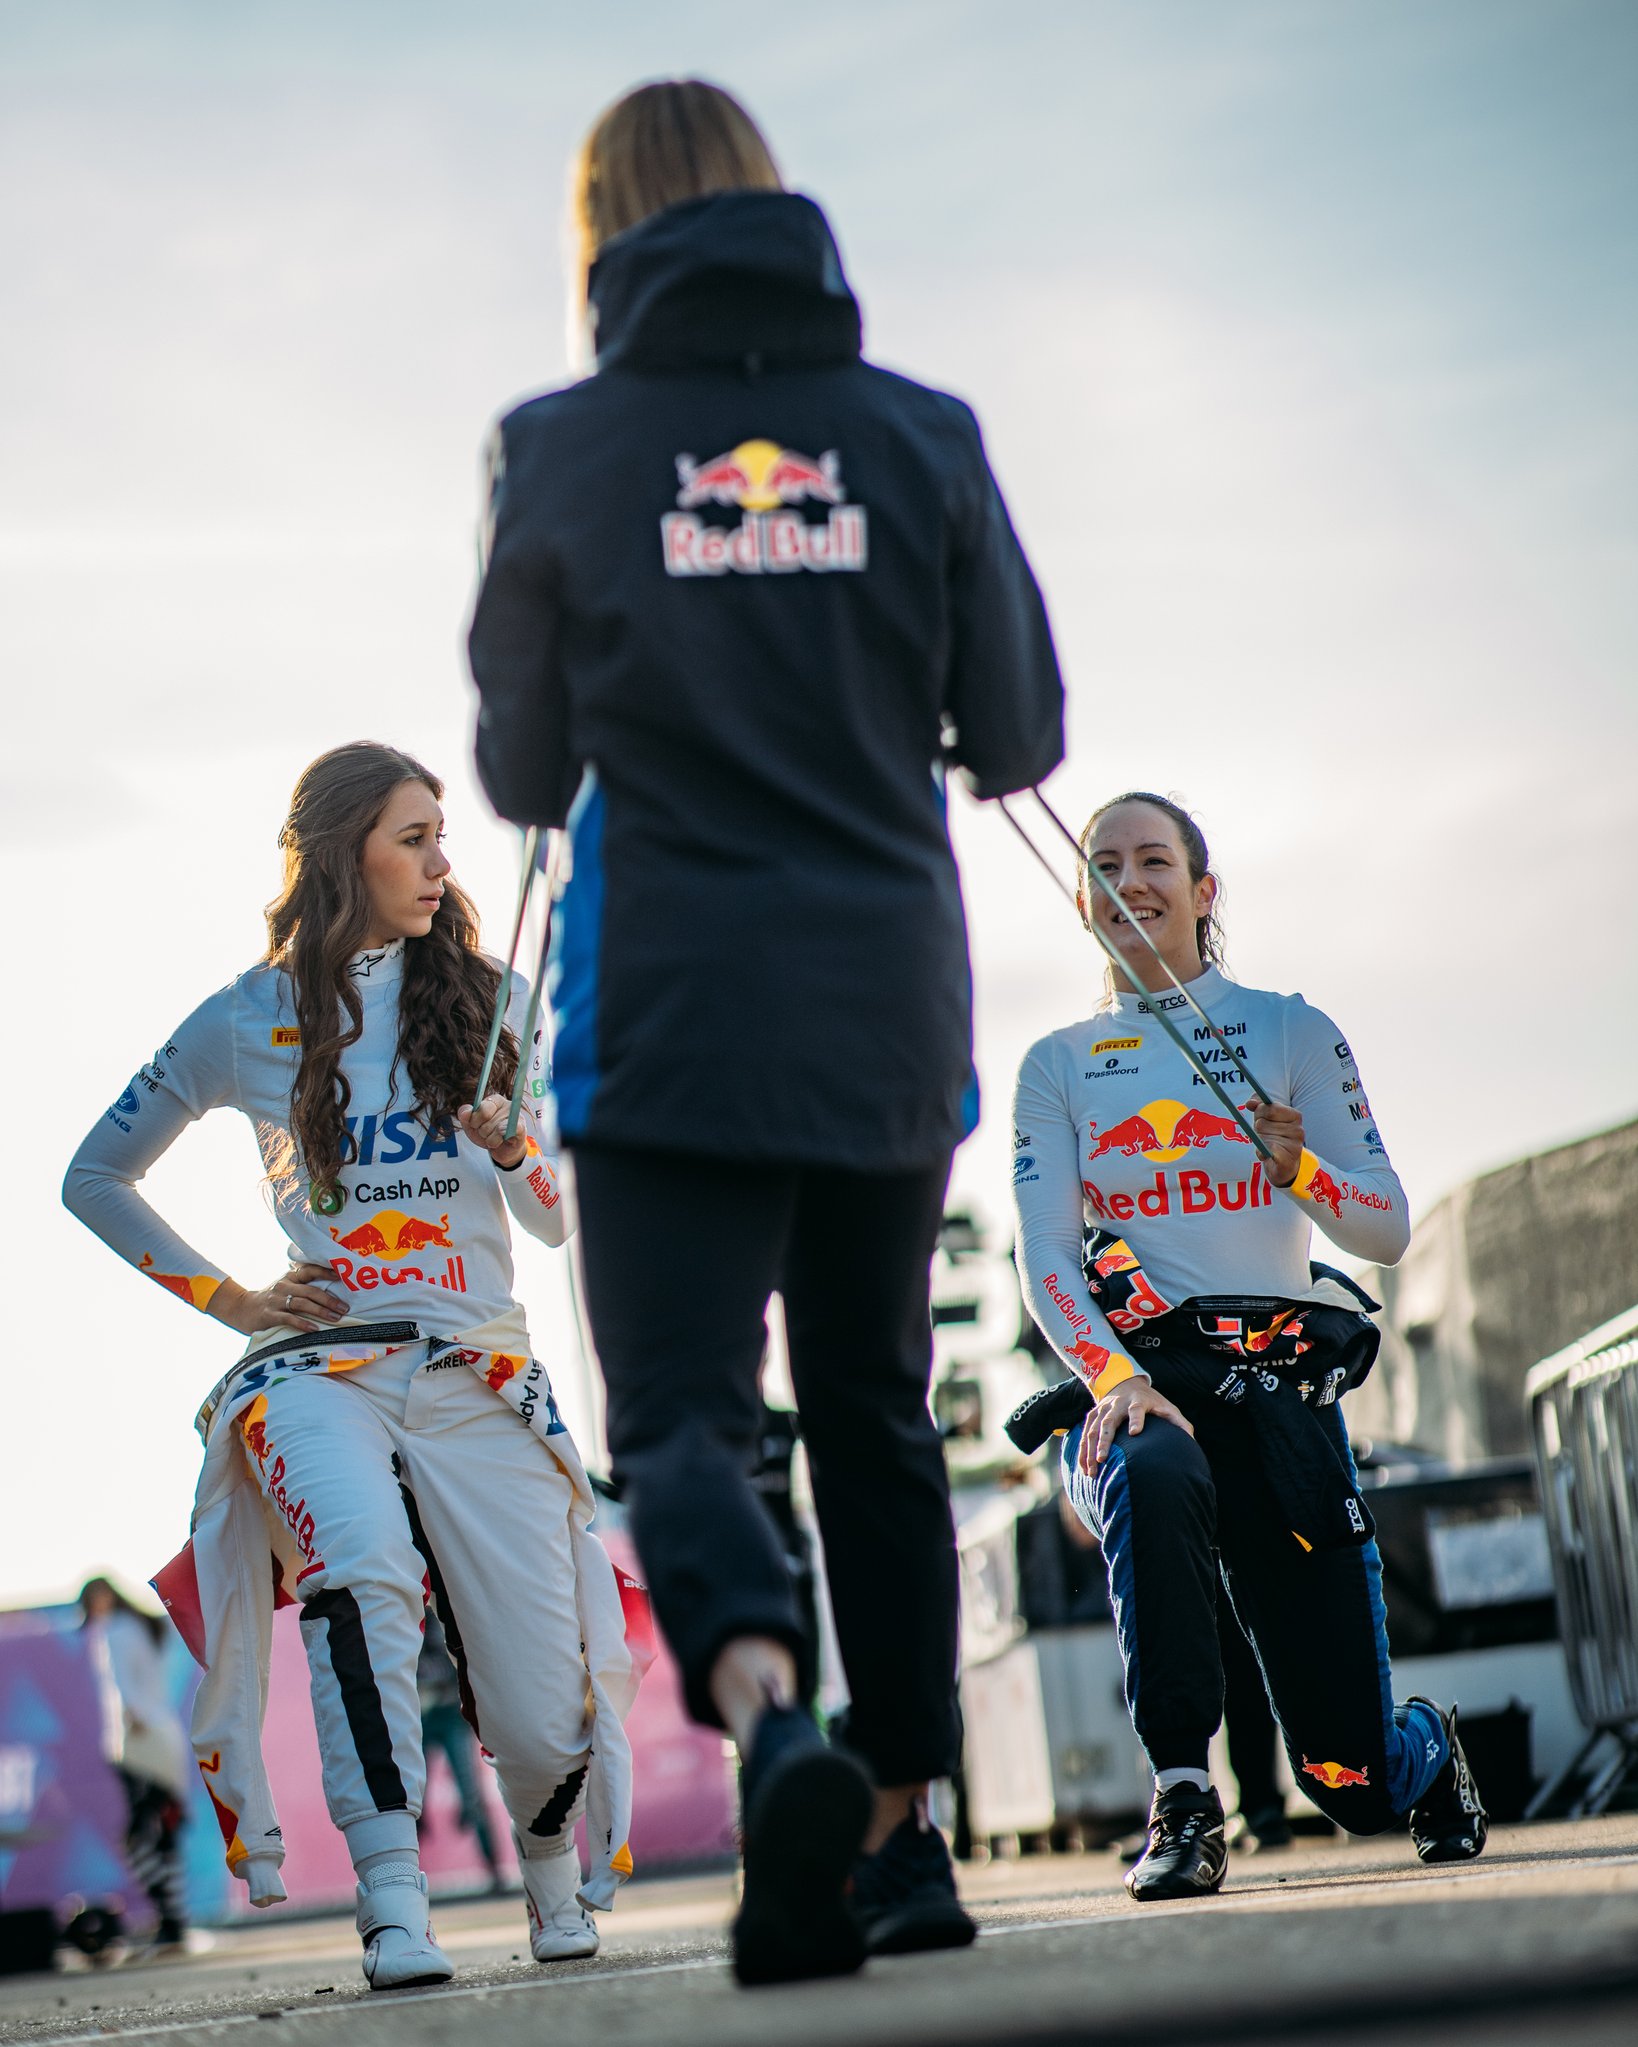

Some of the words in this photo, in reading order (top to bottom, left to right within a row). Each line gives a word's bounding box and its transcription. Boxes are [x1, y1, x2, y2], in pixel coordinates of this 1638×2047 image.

[661, 511, 763, 577] Red
[764, 503, 867, 573] Bull
[1095, 1039, 1139, 1054] PIRELLI
[1084, 1066, 1140, 1080] 1Password
[354, 1180, 413, 1204] Cash
[418, 1176, 460, 1200] App
[1082, 1171, 1170, 1221] Red
[1178, 1162, 1273, 1215] Bull
